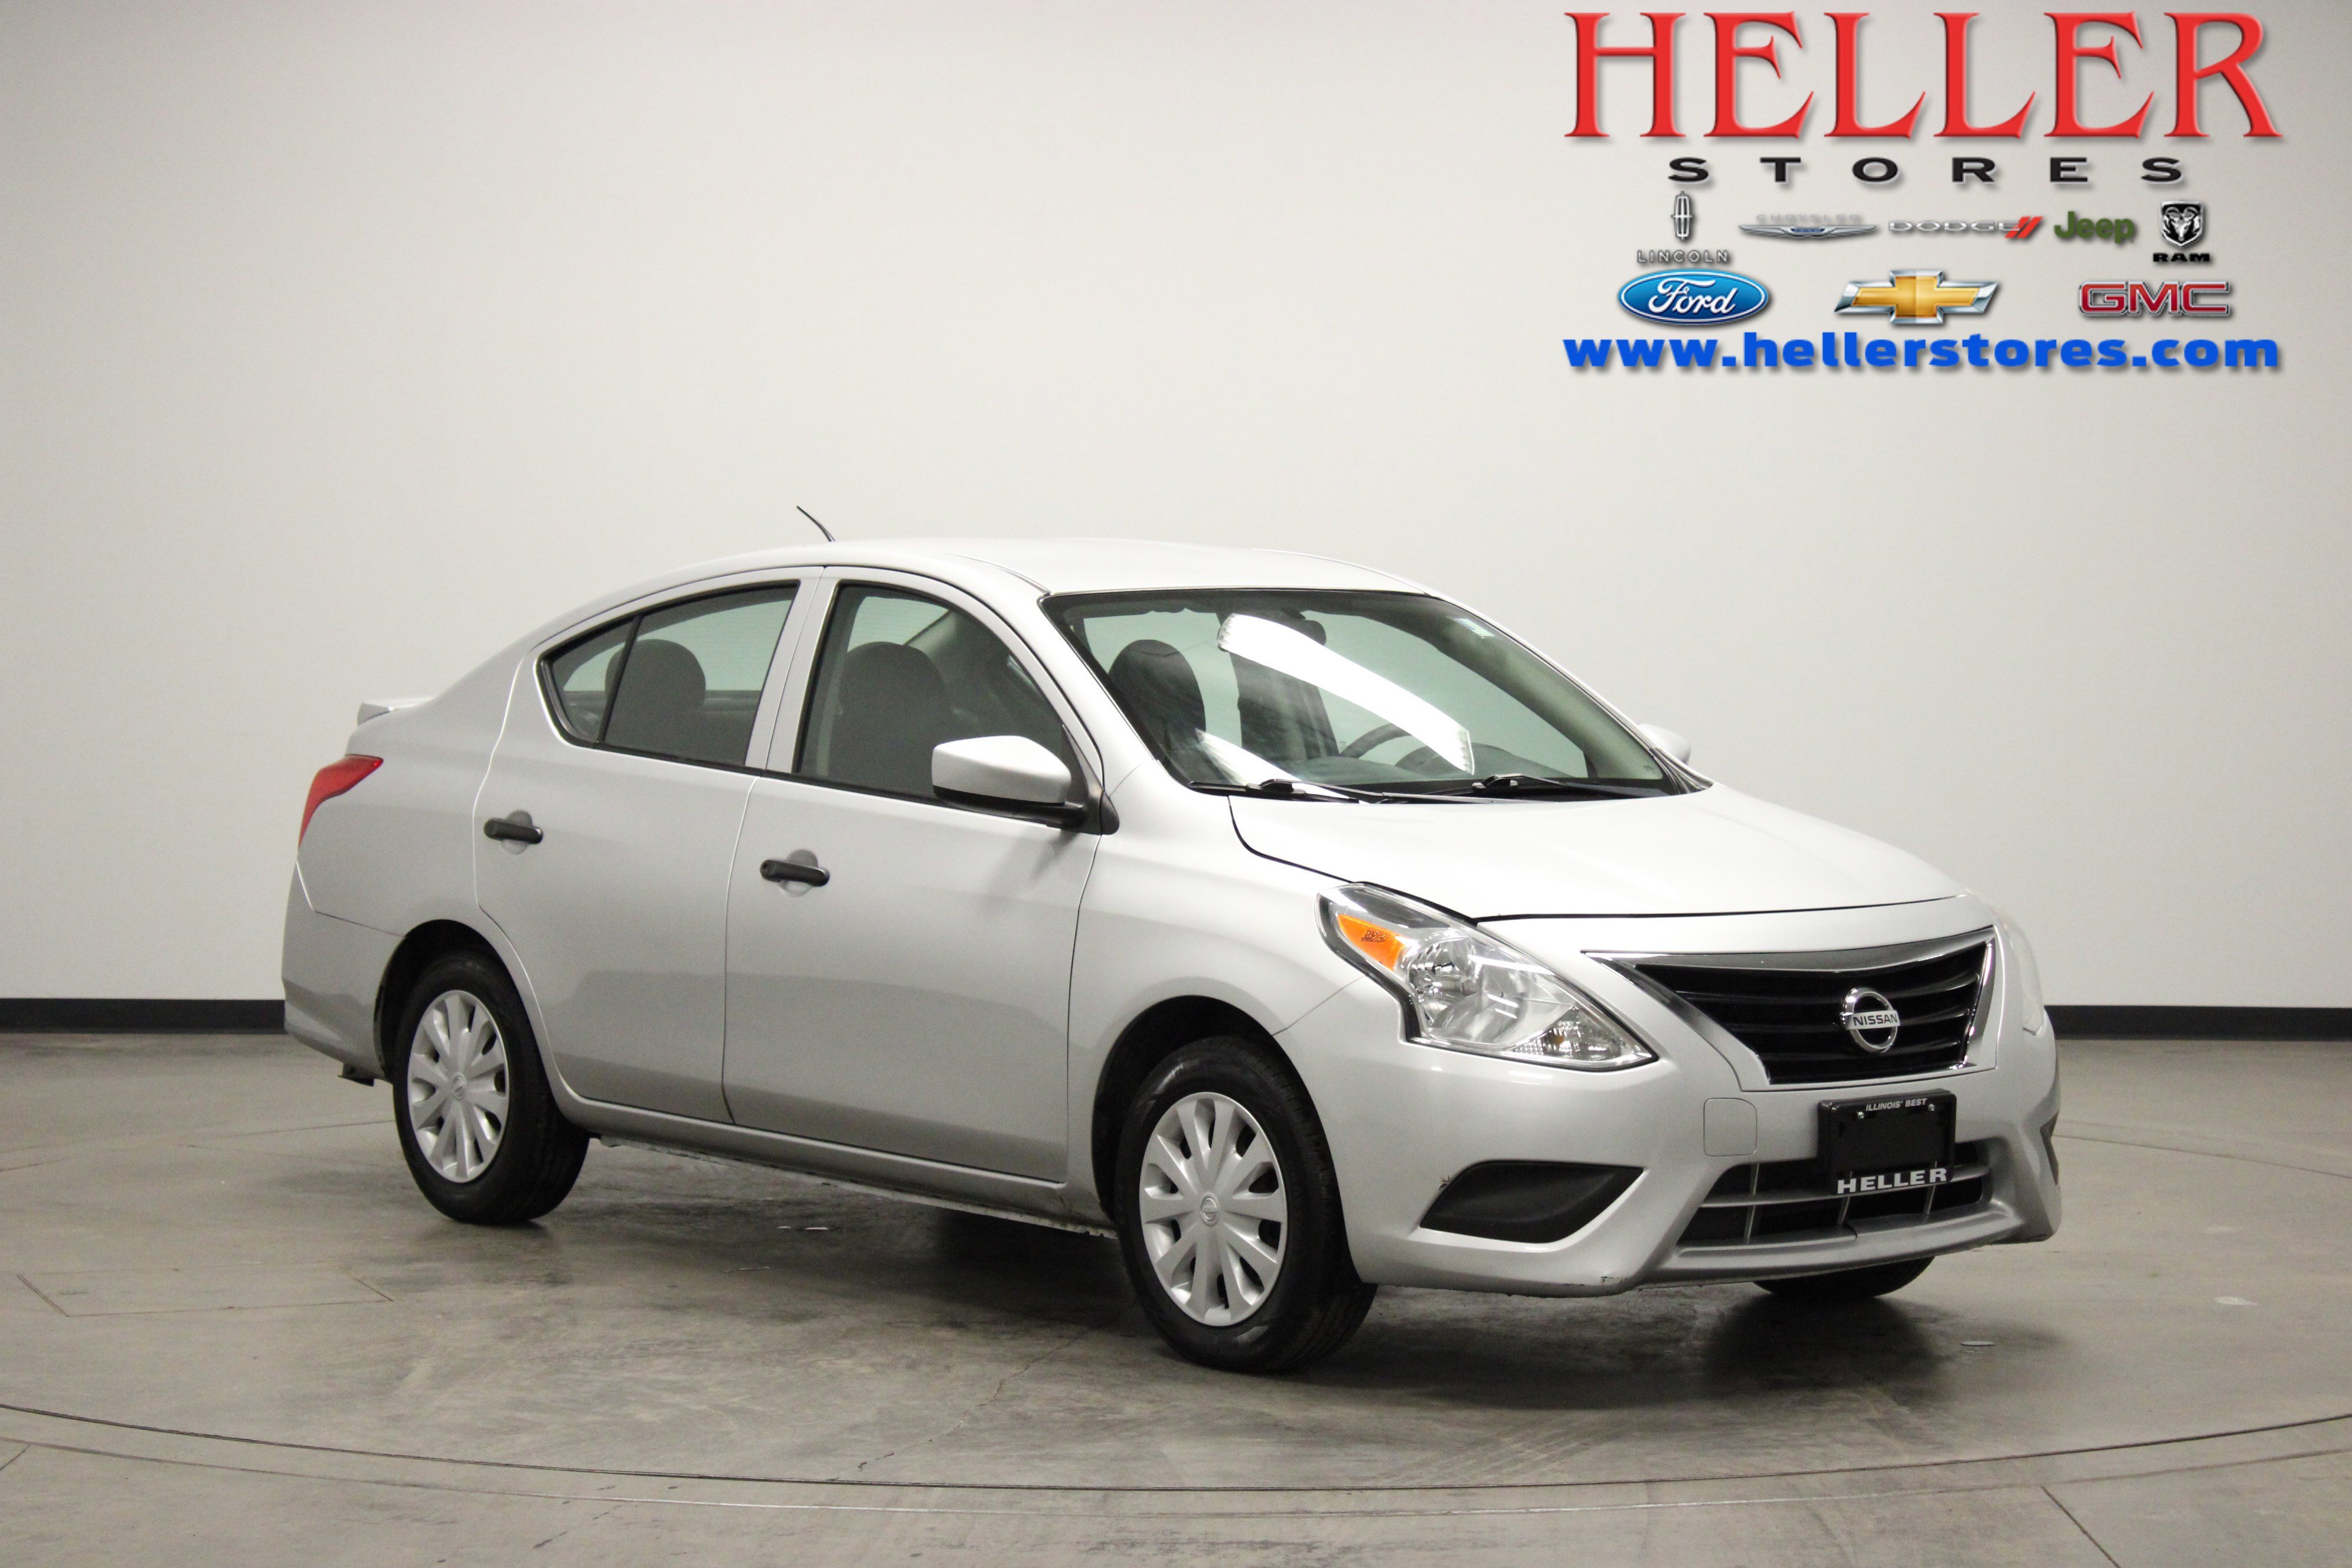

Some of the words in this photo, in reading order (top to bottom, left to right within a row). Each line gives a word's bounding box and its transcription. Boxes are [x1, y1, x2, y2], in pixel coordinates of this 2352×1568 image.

[1853, 1014, 1898, 1026] NISSAN
[1905, 1098, 1927, 1107] BEST
[1837, 1167, 1947, 1194] HELLER
